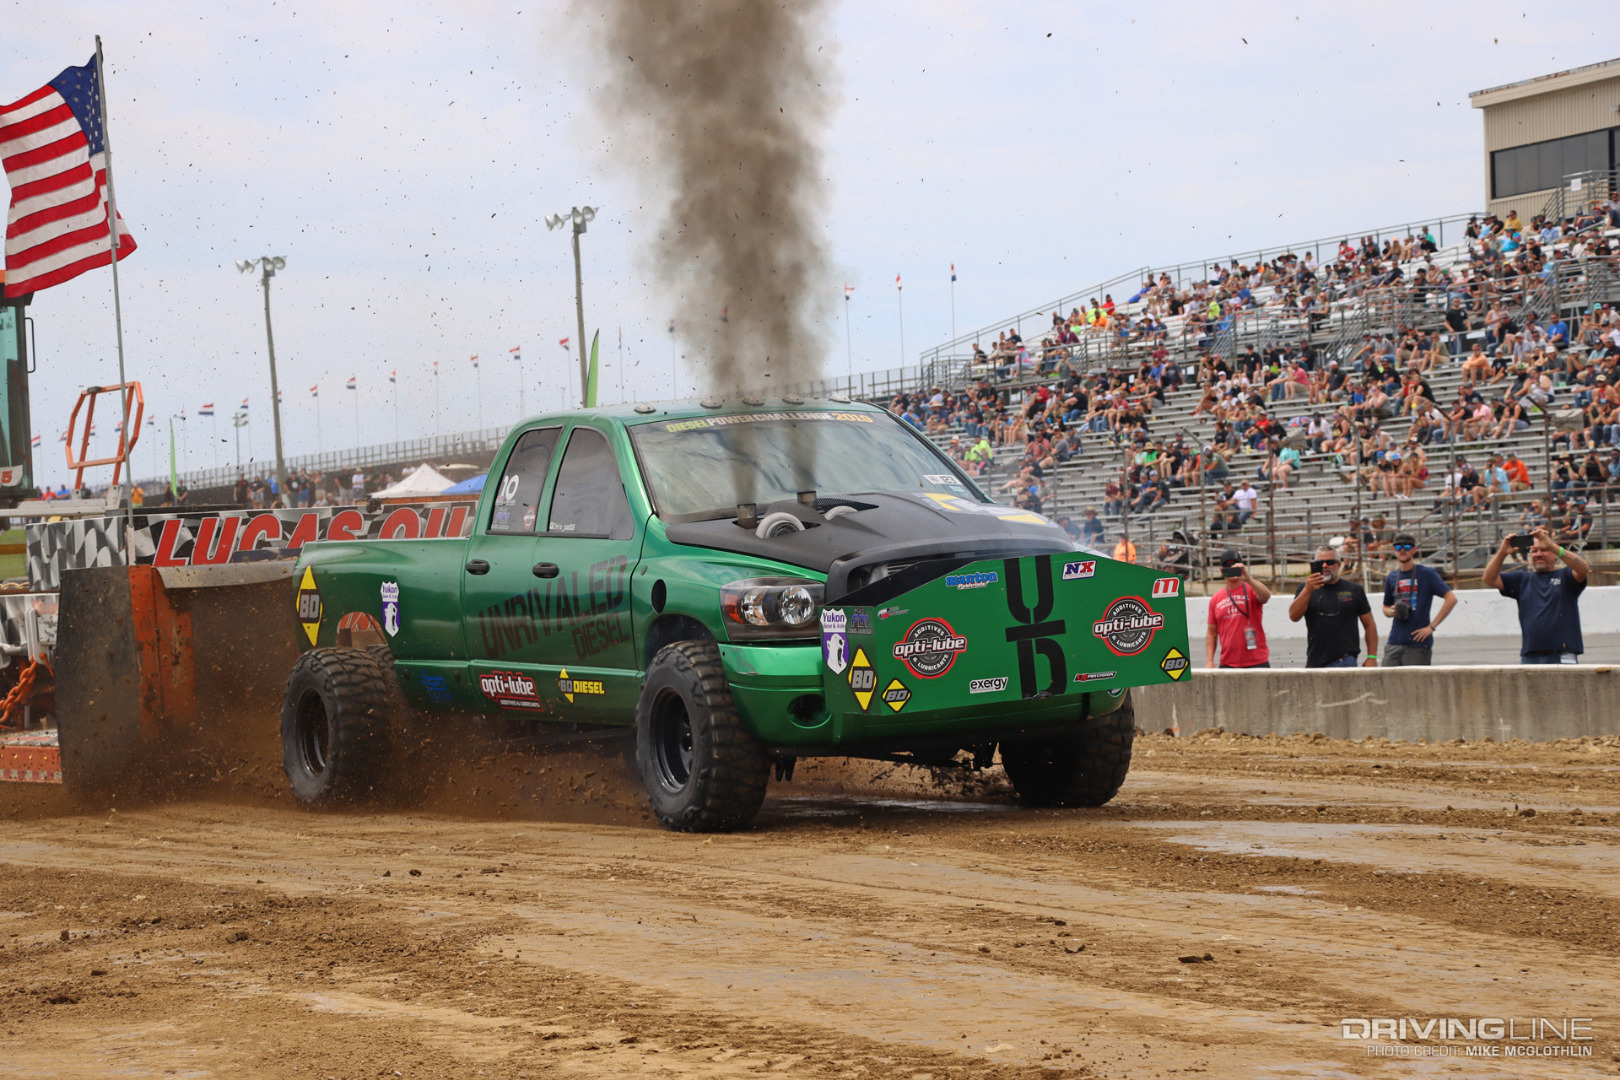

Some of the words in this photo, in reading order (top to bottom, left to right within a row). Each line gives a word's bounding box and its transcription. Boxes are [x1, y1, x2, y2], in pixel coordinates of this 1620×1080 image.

[501, 475, 520, 501] 10
[151, 510, 364, 567] LUCAS
[1065, 562, 1095, 574] NX
[946, 572, 998, 586] manton
[300, 594, 320, 618] BD
[479, 555, 628, 659] UNRIVALED
[1113, 603, 1143, 616] ADDITIVES
[823, 612, 845, 623] Yukon
[1094, 615, 1163, 636] opti-lube
[571, 611, 631, 661] DIESEL
[914, 625, 945, 638] ADDITIVES
[1116, 631, 1147, 648] LUBRICANTS
[895, 637, 965, 657] opti-lube
[917, 654, 949, 670] LUBRICANTS
[1165, 658, 1187, 670] BD
[481, 675, 535, 696] opti-lube
[560, 680, 572, 692] BD
[573, 680, 605, 694] DIESEL
[852, 670, 874, 689] BD
[971, 678, 1007, 690] exergy
[886, 690, 908, 701] BD
